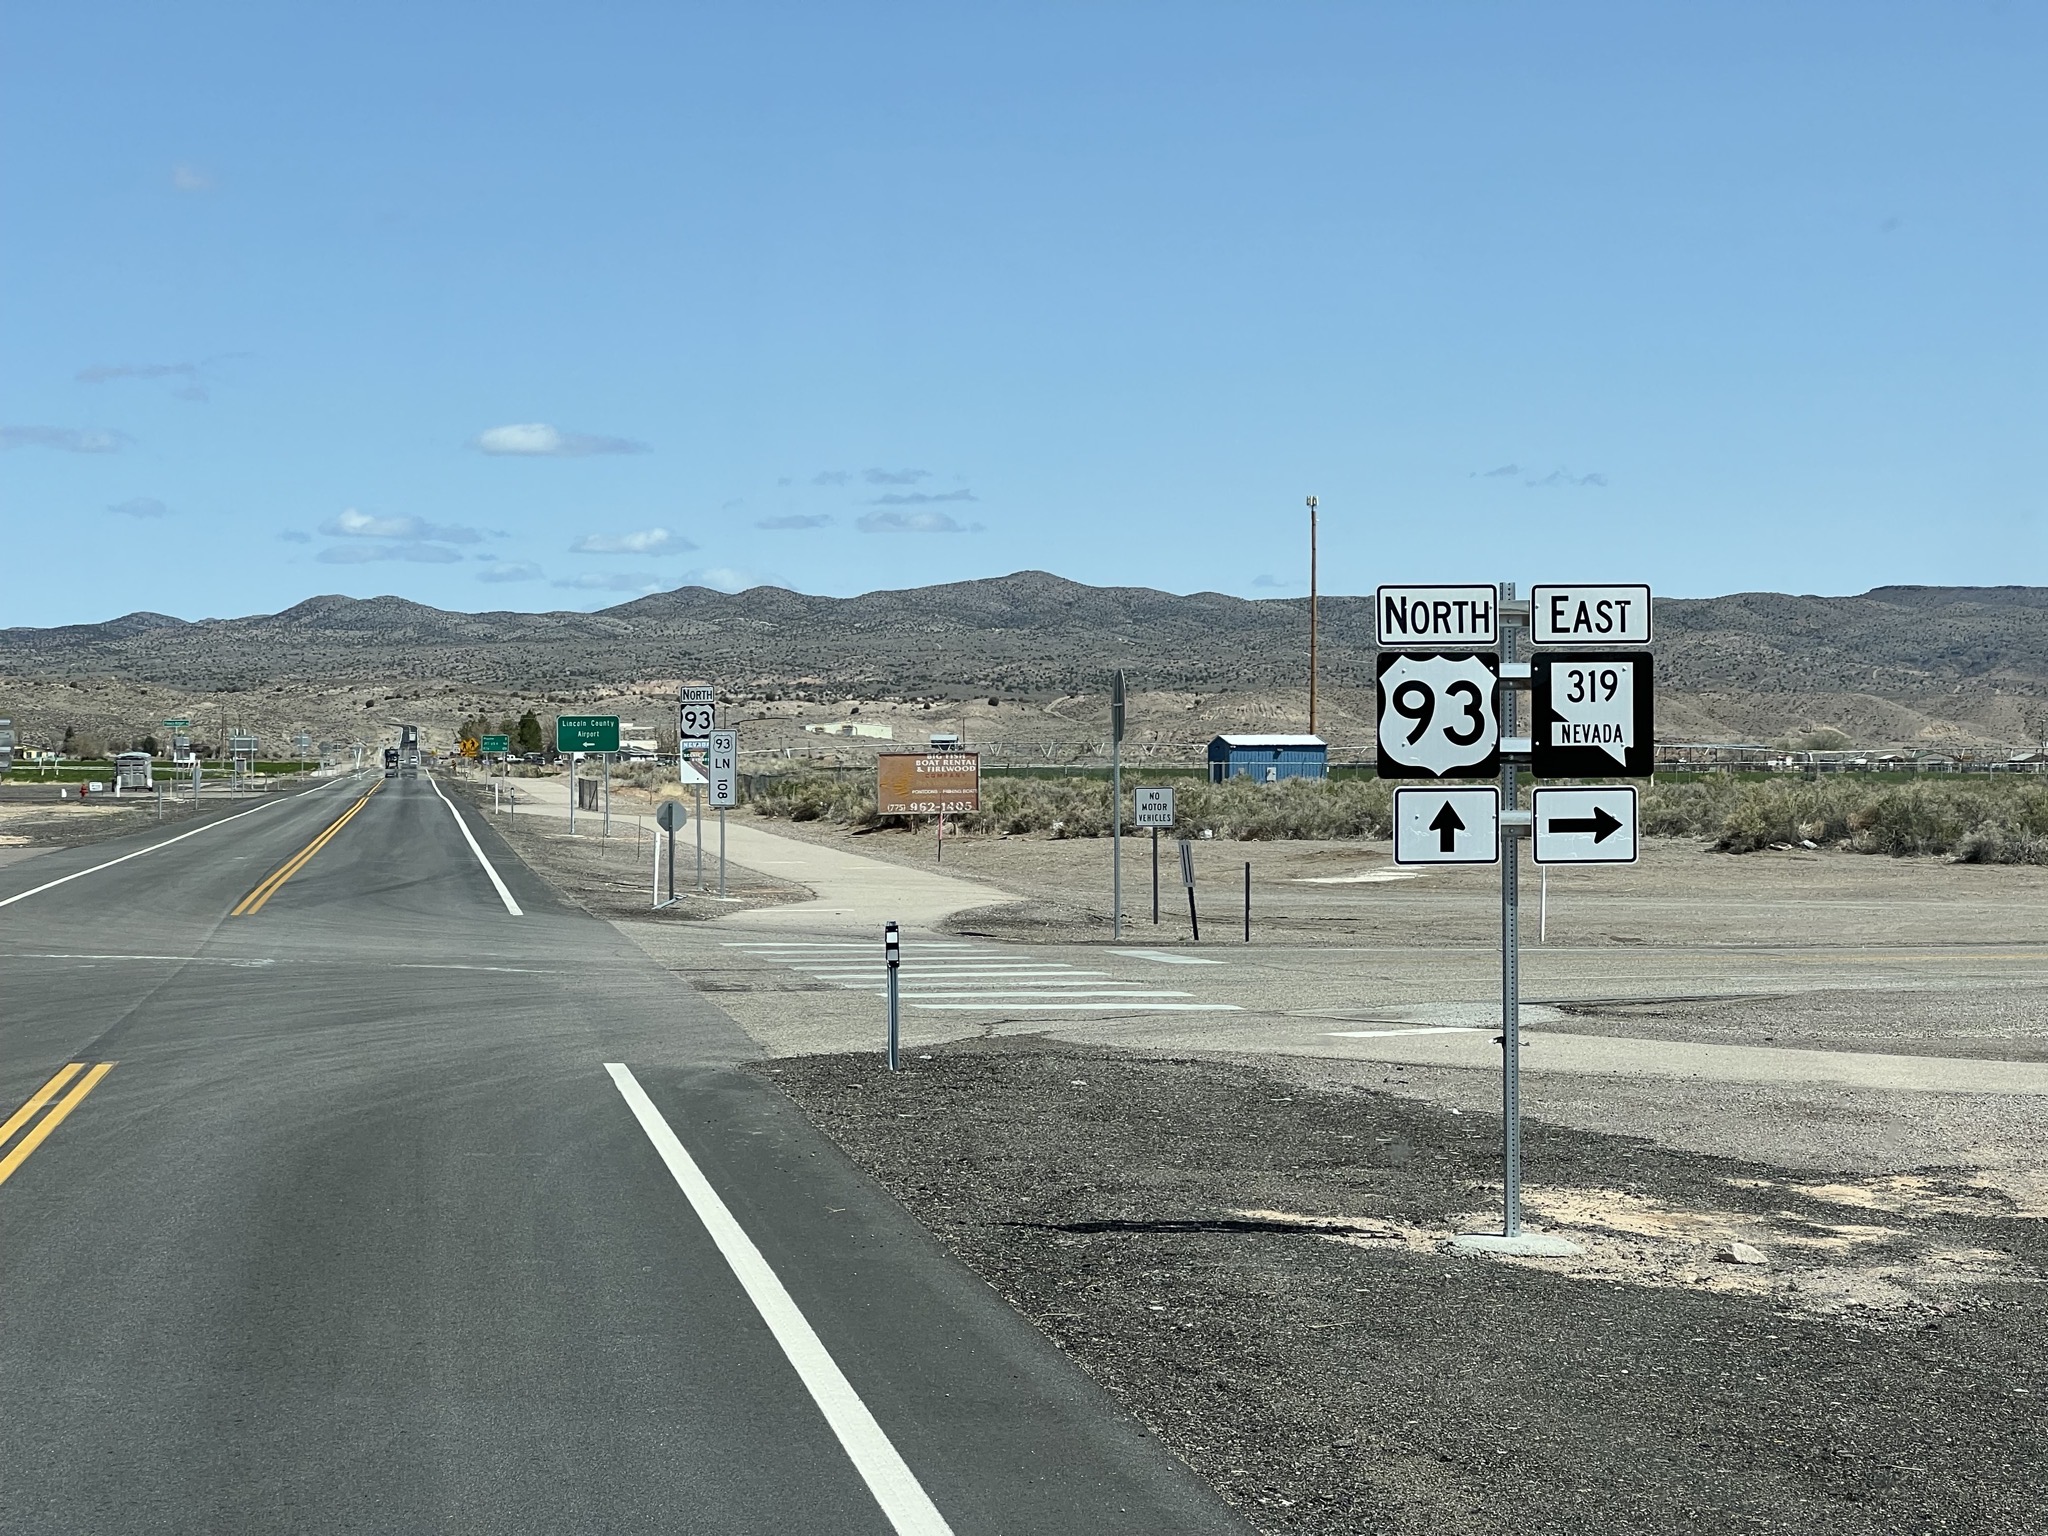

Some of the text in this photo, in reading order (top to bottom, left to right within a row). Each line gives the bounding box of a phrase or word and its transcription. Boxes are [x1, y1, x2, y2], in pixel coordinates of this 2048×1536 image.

[1385, 595, 1490, 635] NORTH
[1550, 595, 1632, 634] EAST
[1566, 669, 1618, 703] 319
[683, 689, 713, 701] NORTH
[1392, 679, 1486, 746] 93
[590, 719, 615, 728] County
[684, 711, 711, 729] 93
[577, 730, 600, 739] Airport
[1561, 723, 1624, 744] NEVADA
[715, 738, 731, 750] 93
[715, 758, 730, 769] LN
[717, 778, 728, 799] 108
[1150, 792, 1160, 800] NO
[887, 803, 906, 812] (775)
[1141, 803, 1168, 811] MOTOR
